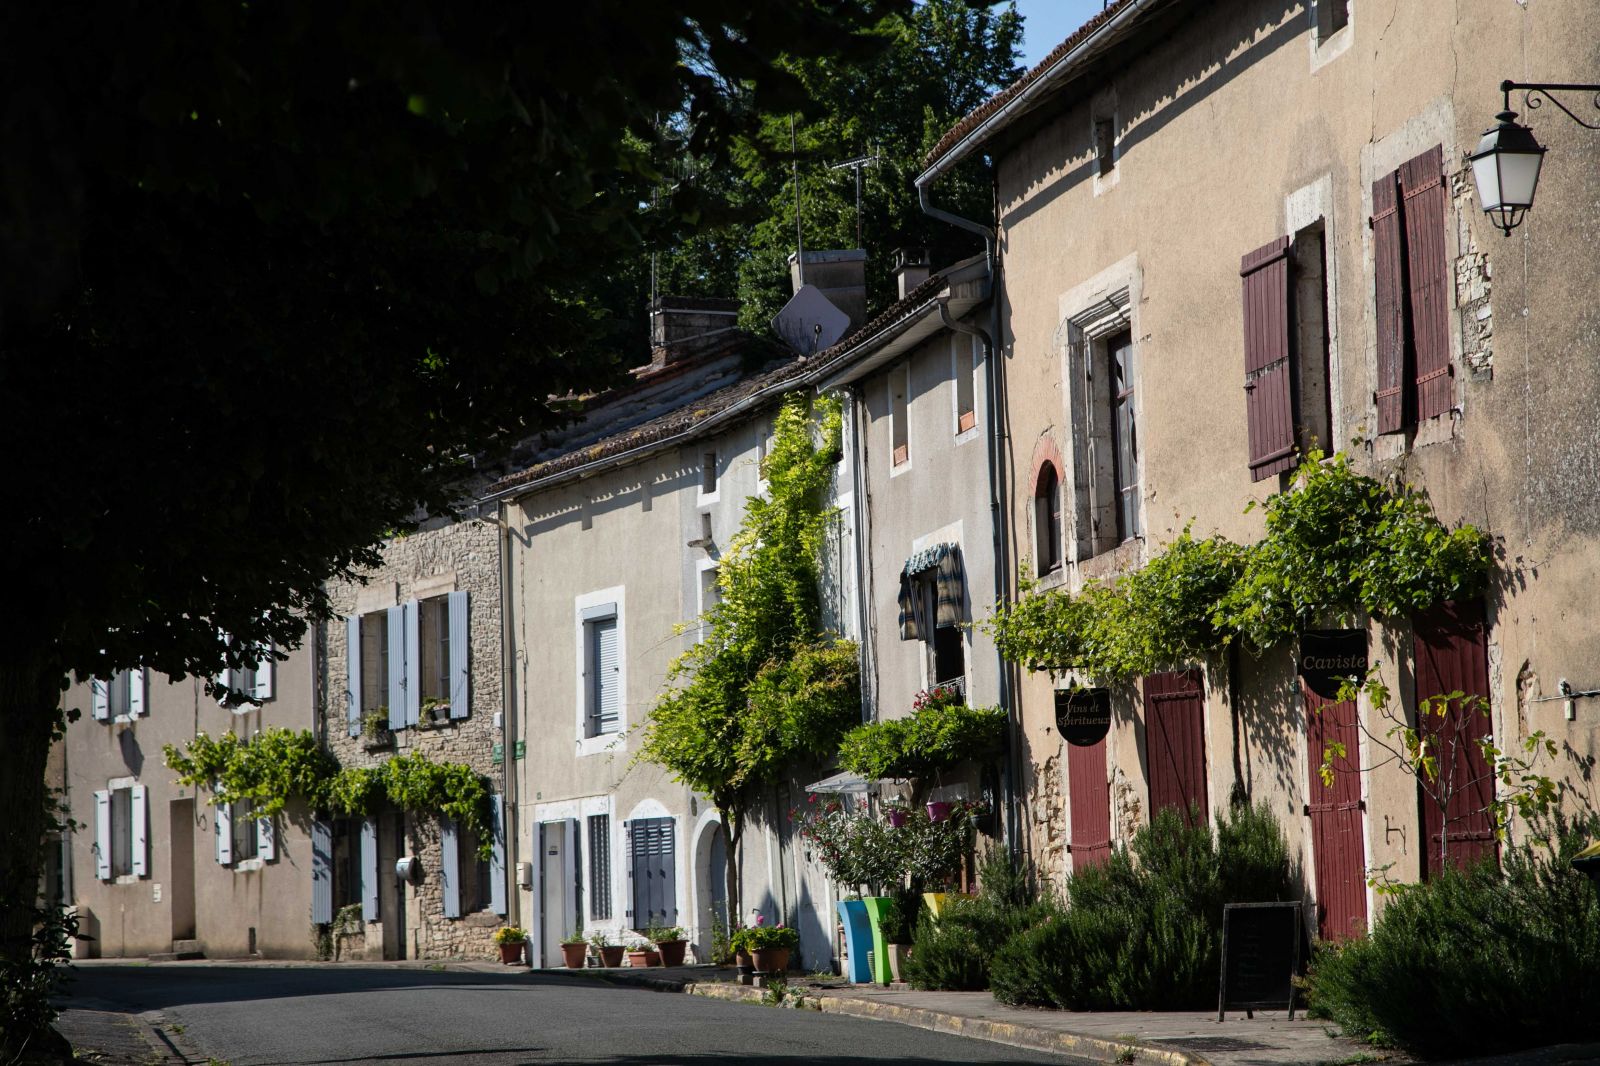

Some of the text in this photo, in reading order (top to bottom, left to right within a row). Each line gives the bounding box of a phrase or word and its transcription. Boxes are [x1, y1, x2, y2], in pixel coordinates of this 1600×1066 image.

[1303, 654, 1366, 670] Caviste
[1067, 703, 1100, 713] Vins et
[1057, 715, 1110, 728] Spiritueux
